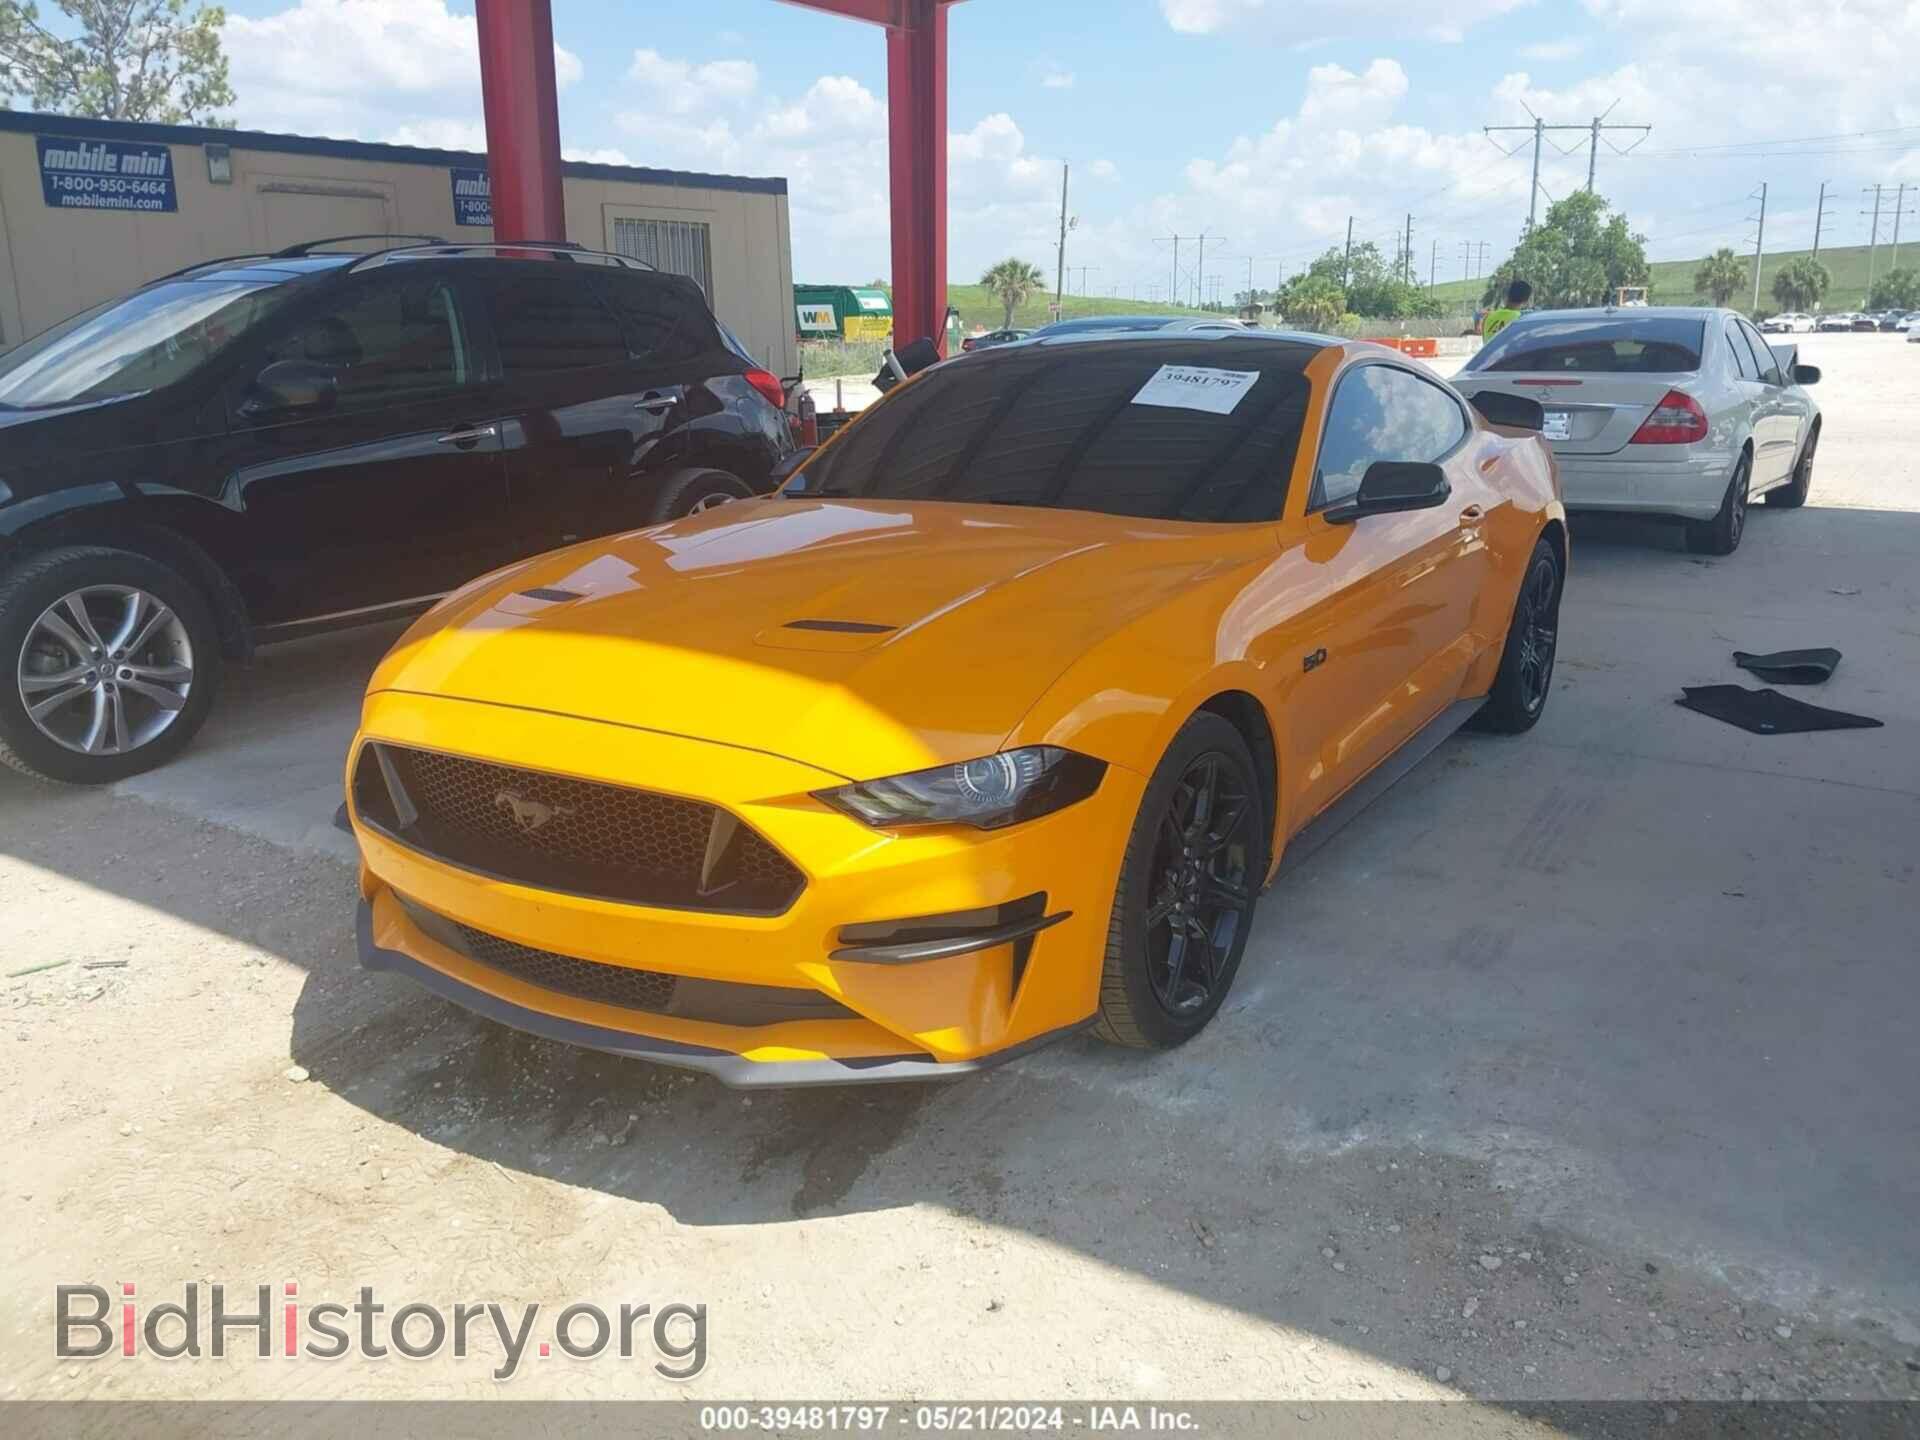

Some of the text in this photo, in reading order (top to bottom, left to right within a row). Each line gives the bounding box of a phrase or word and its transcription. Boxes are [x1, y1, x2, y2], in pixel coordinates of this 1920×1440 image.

[44, 142, 167, 175] mobile mini
[52, 175, 166, 194] 1-800-950-6464
[61, 193, 163, 209] mobilemini.com
[803, 311, 831, 324] WM
[1166, 373, 1241, 388] 39481797
